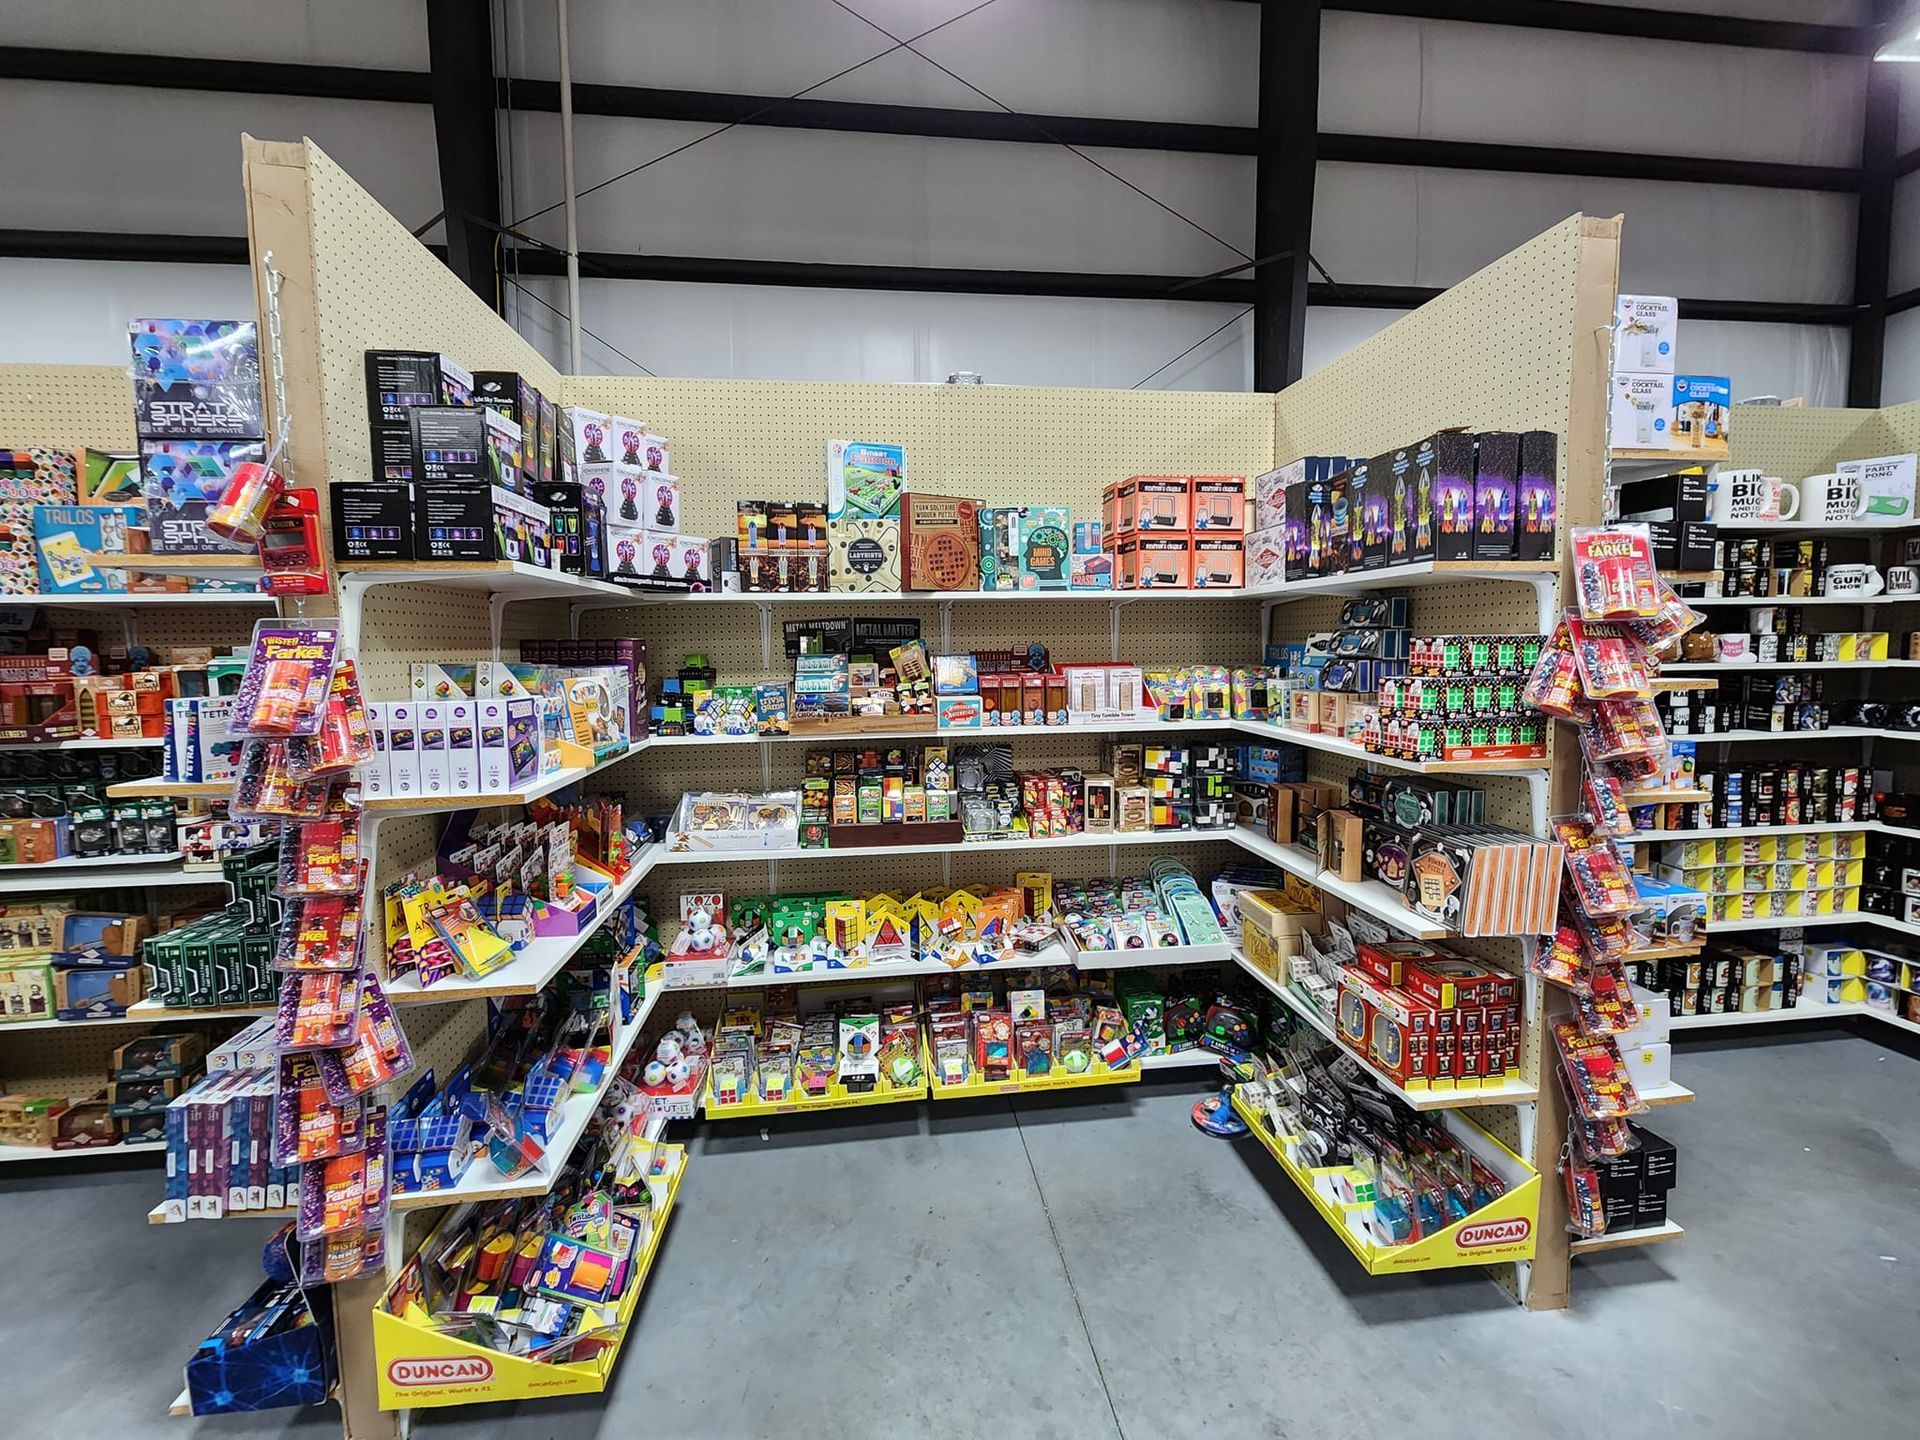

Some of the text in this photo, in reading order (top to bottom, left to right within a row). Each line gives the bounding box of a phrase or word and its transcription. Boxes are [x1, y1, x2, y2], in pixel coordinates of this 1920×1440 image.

[1636, 304, 1669, 312] COCKTAIL
[152, 414, 244, 427] SPHERE
[1865, 464, 1899, 474] PARTY
[1865, 471, 1893, 479] PONG
[1743, 474, 1762, 483] LIK
[1838, 478, 1857, 486] LIK
[44, 509, 95, 525] TRILOS
[1033, 547, 1052, 557] MIND
[1588, 543, 1635, 557] FARKEL
[1030, 557, 1055, 566] GAMES
[1889, 570, 1911, 582] EVIL
[855, 623, 883, 637] METAL
[1583, 624, 1624, 637] FARKEL
[261, 637, 299, 646] TWISTED
[164, 745, 172, 777] TETRA
[186, 745, 195, 777] TETRA
[685, 895, 721, 906] KOZO
[1463, 1224, 1525, 1242] DUNCAN
[397, 1362, 484, 1379] DUNCAN
